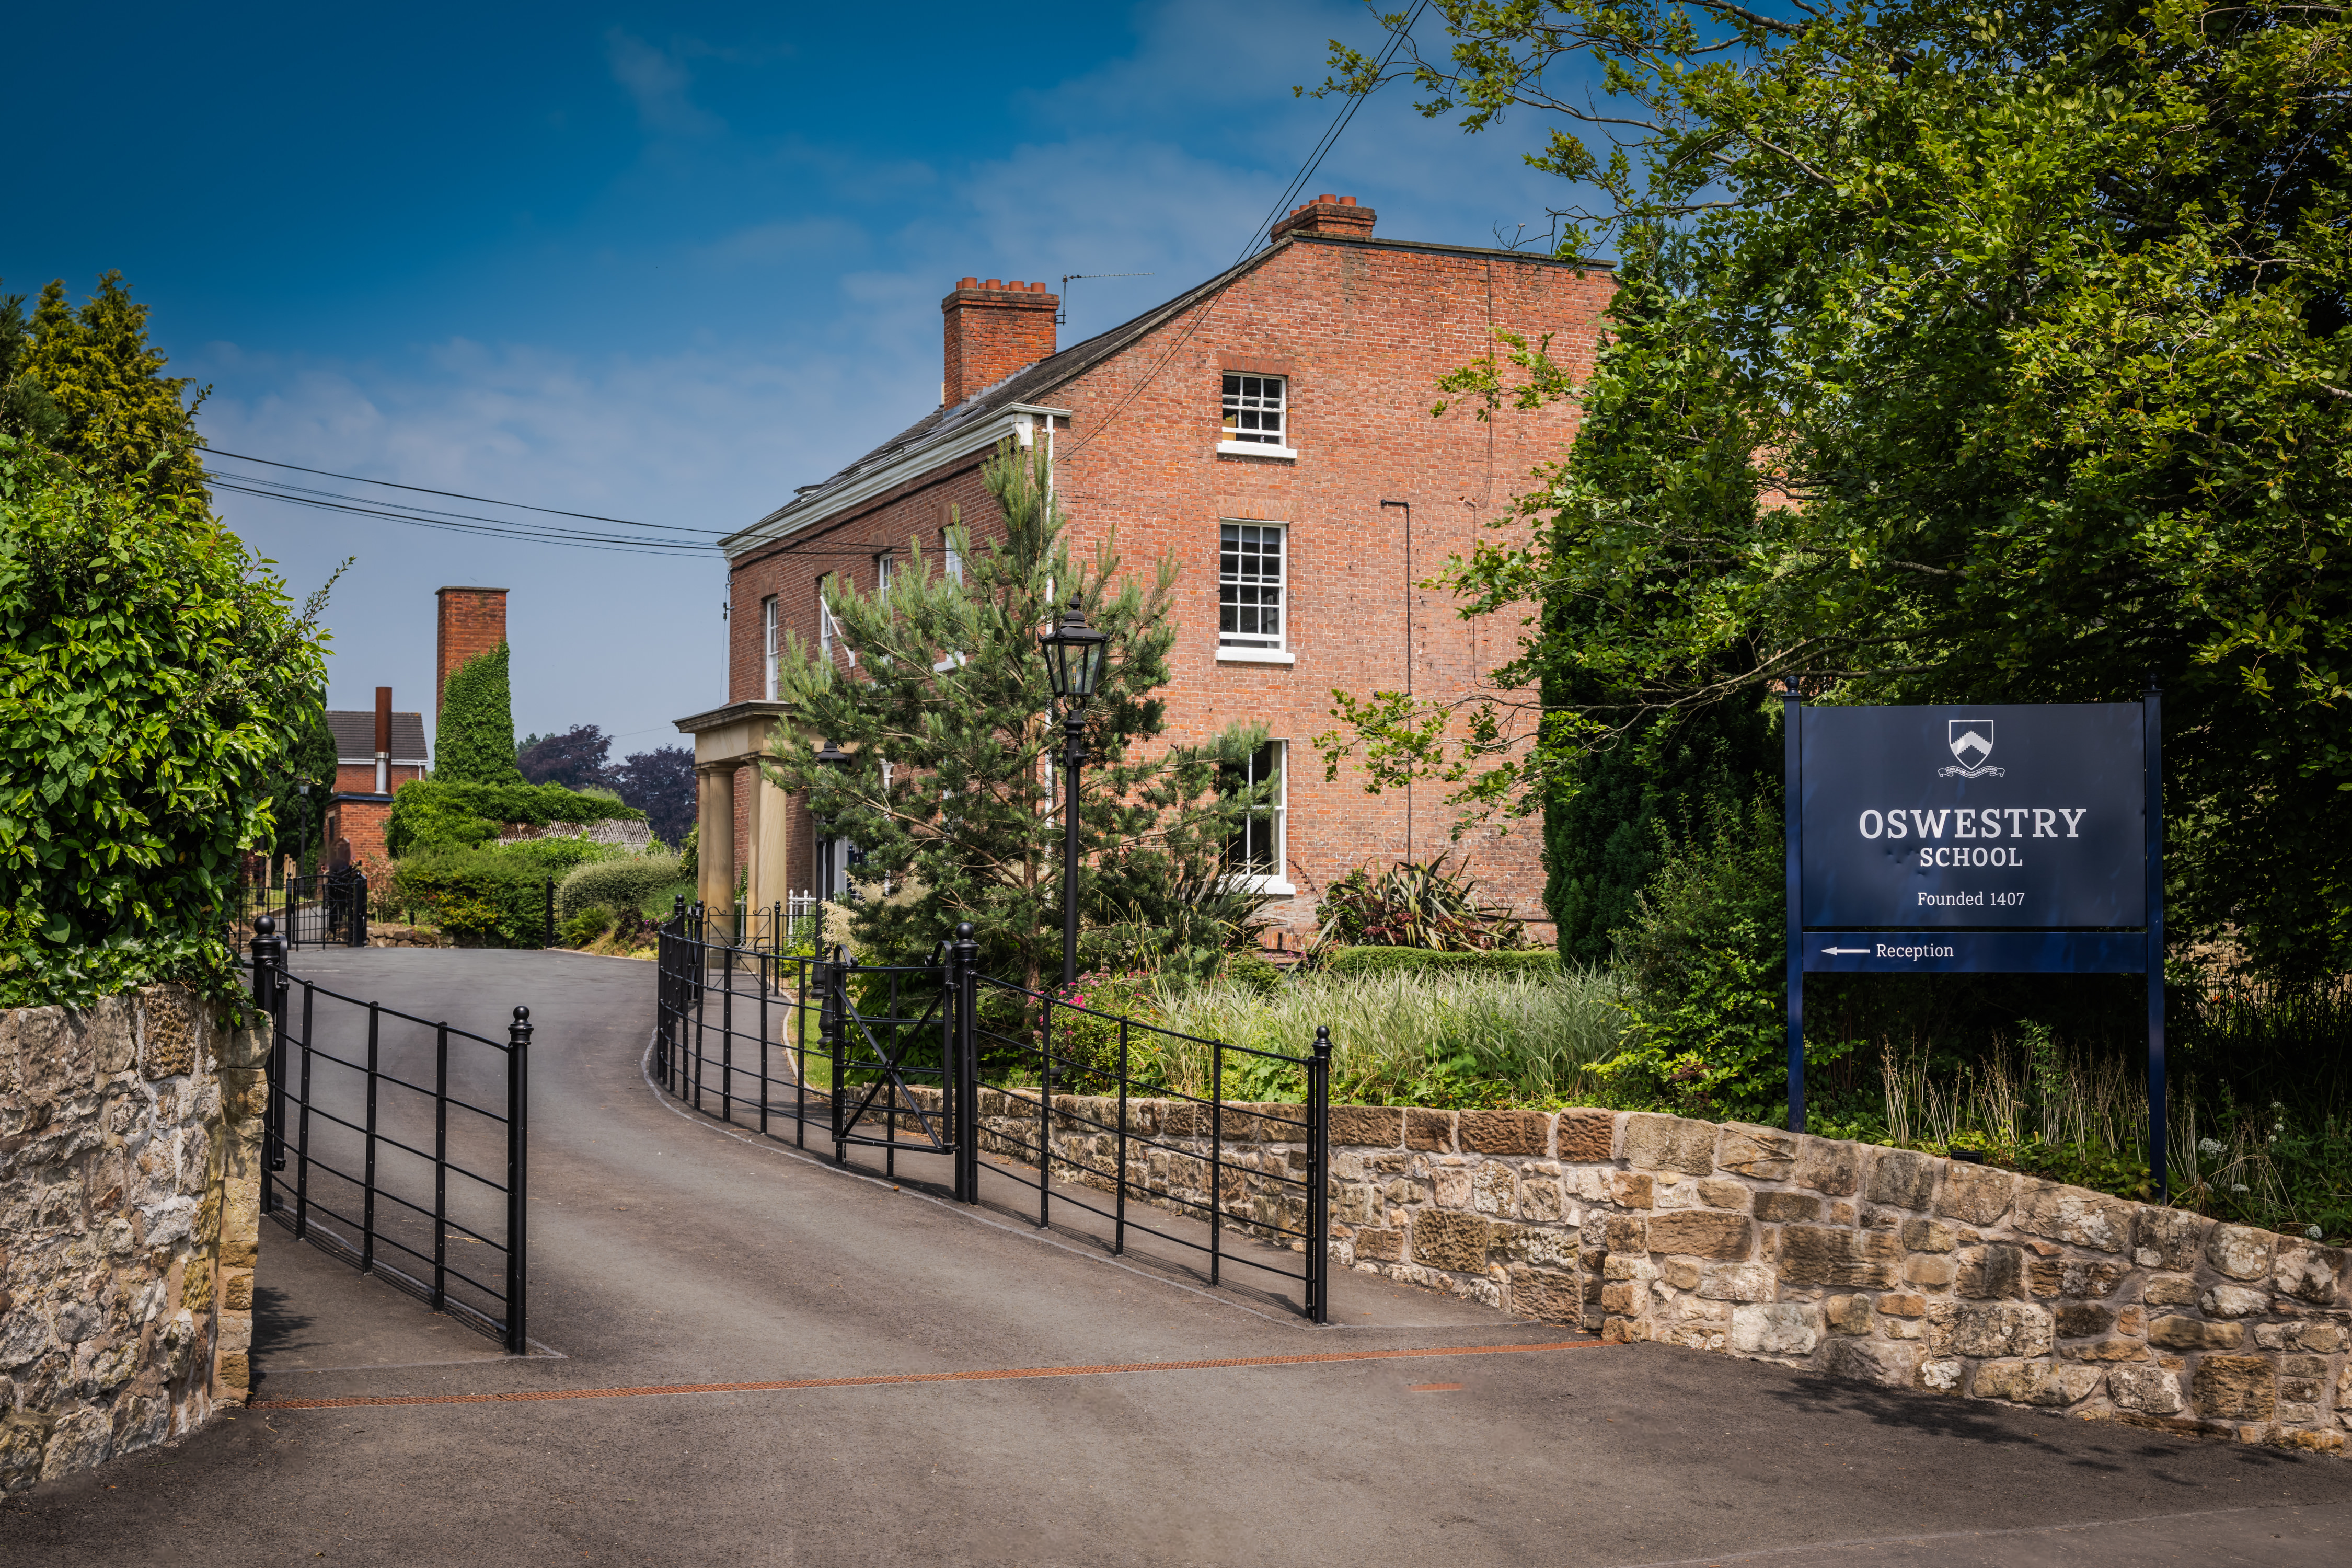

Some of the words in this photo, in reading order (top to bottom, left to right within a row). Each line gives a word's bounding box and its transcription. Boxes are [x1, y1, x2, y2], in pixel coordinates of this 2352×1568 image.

[1859, 808, 2086, 839] OSWESTRY
[1920, 847, 2023, 867] SCHOOL
[1918, 891, 1984, 906] Founded
[1990, 892, 2025, 906] 1407
[1876, 943, 1954, 962] Reception
